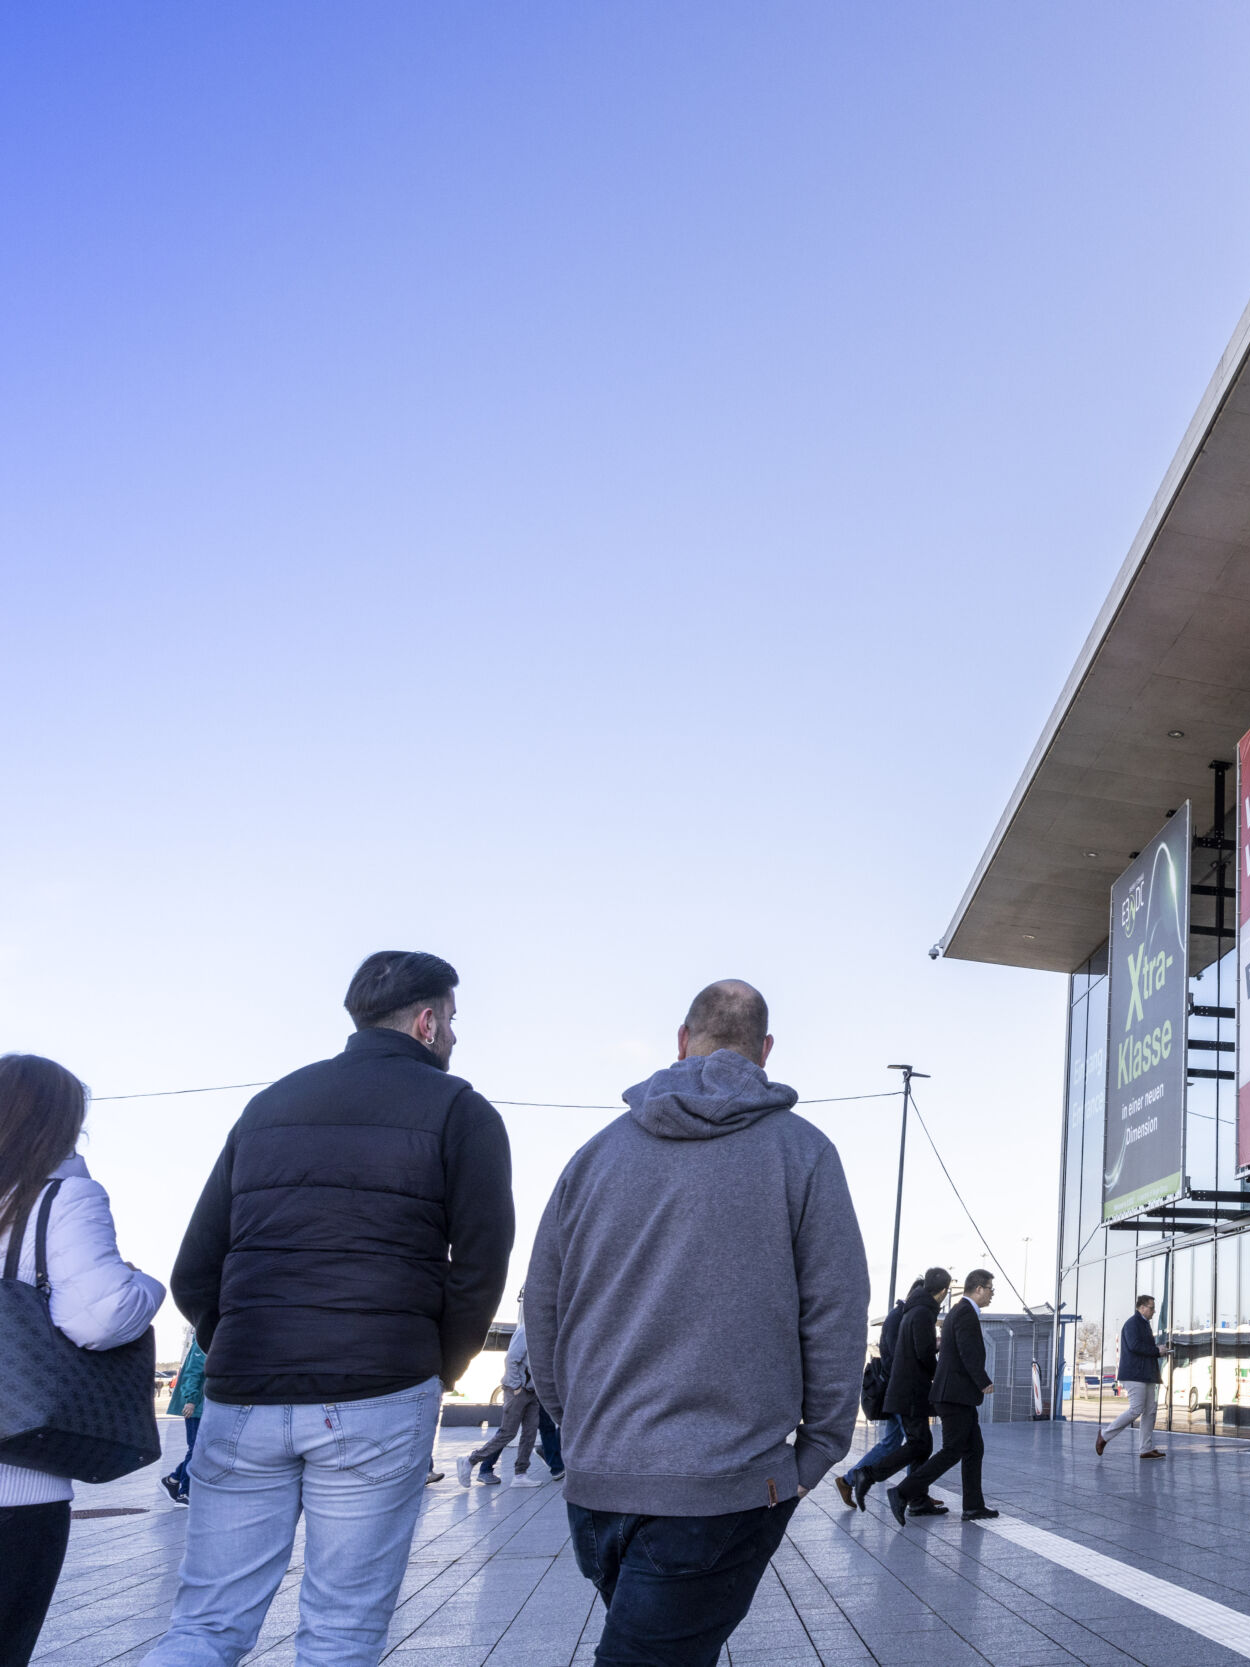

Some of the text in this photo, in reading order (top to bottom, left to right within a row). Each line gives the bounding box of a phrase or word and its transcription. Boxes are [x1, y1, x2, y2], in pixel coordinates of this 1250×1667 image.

[1125, 942, 1174, 1032] Xtra-
[1117, 1019, 1172, 1090] Klasse
[1121, 1082, 1164, 1121] in einer neuen
[1126, 1115, 1158, 1146] Dimension
